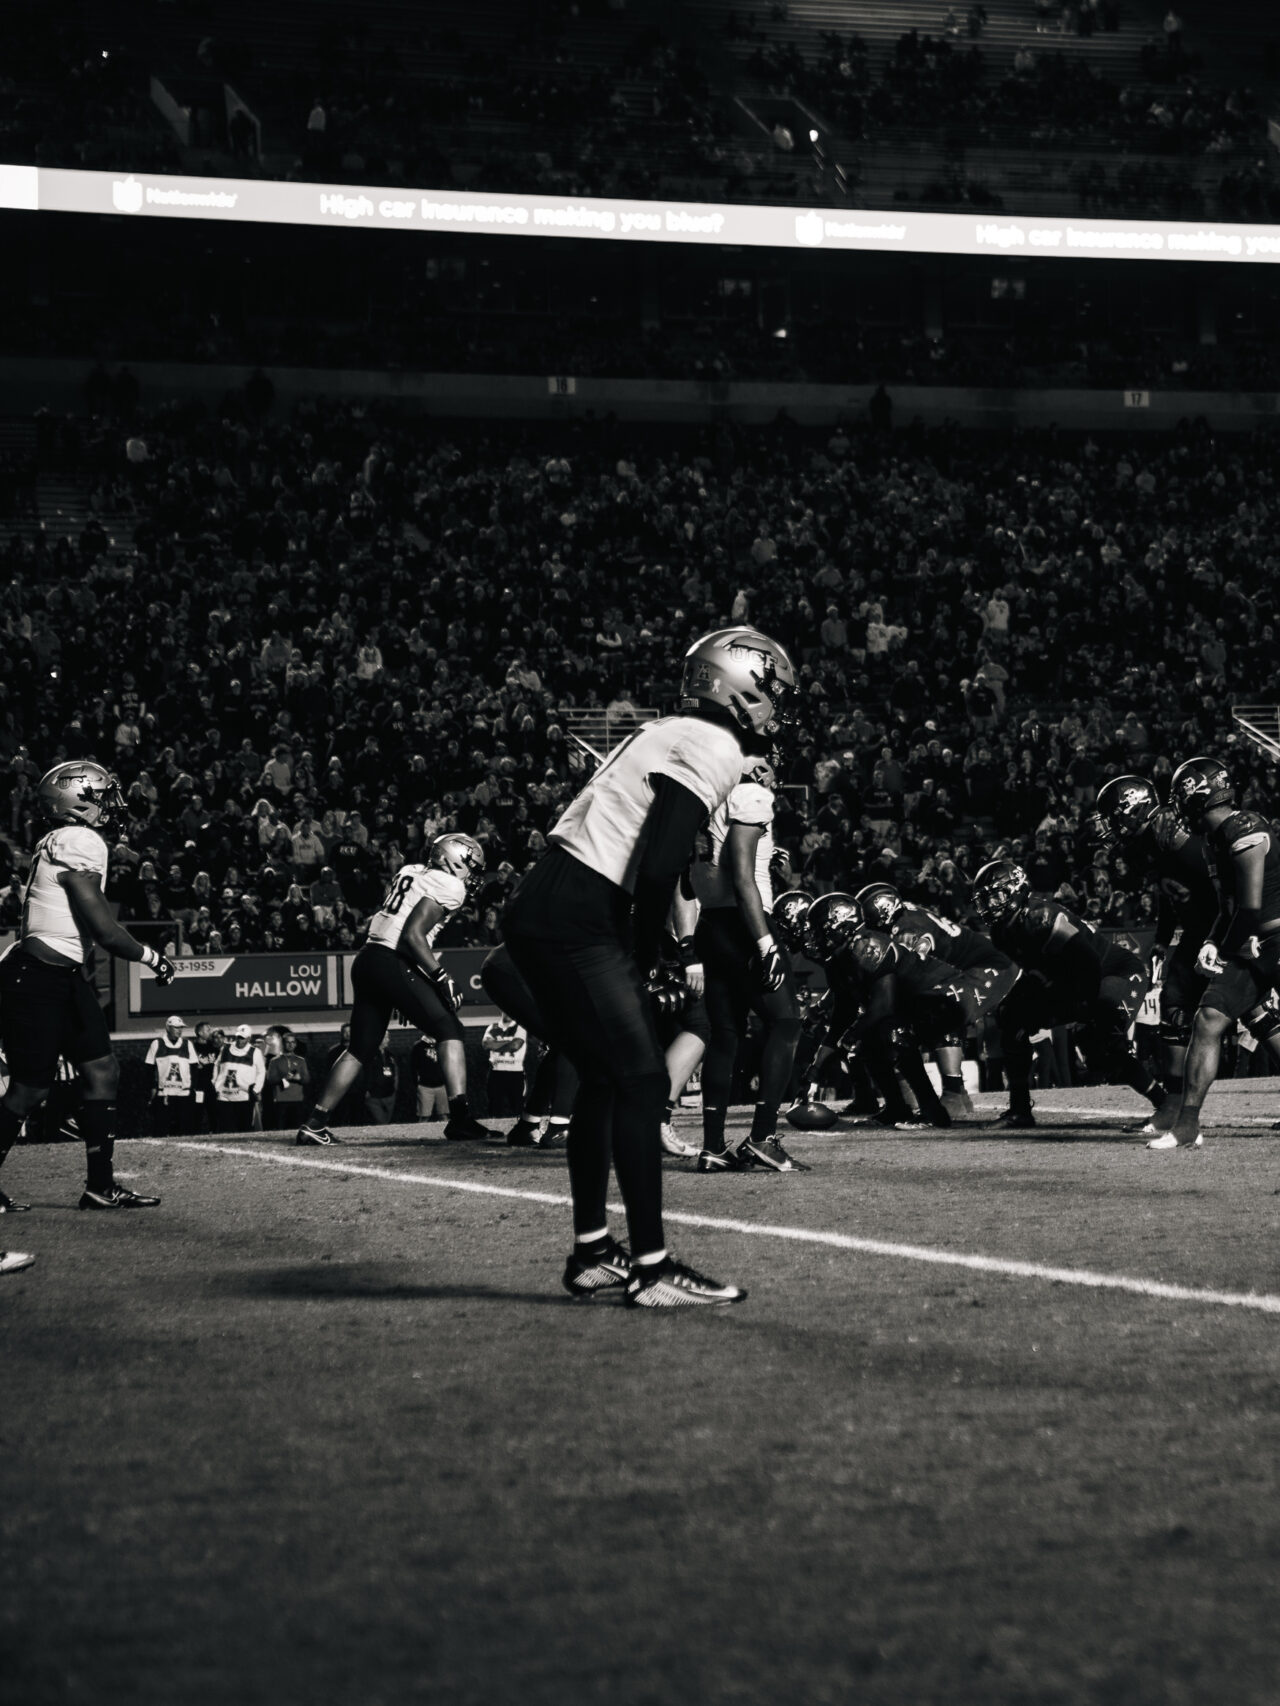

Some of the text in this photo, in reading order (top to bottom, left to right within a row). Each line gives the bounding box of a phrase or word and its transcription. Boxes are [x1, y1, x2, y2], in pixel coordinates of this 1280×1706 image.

[147, 188, 237, 207] Nationwide
[321, 195, 724, 232] High car insurance making you blue?
[976, 225, 1024, 247] High
[1131, 392, 1142, 406] 17
[173, 961, 215, 972] 53-1955
[290, 964, 321, 978] LOU
[235, 980, 321, 998] HALLOW
